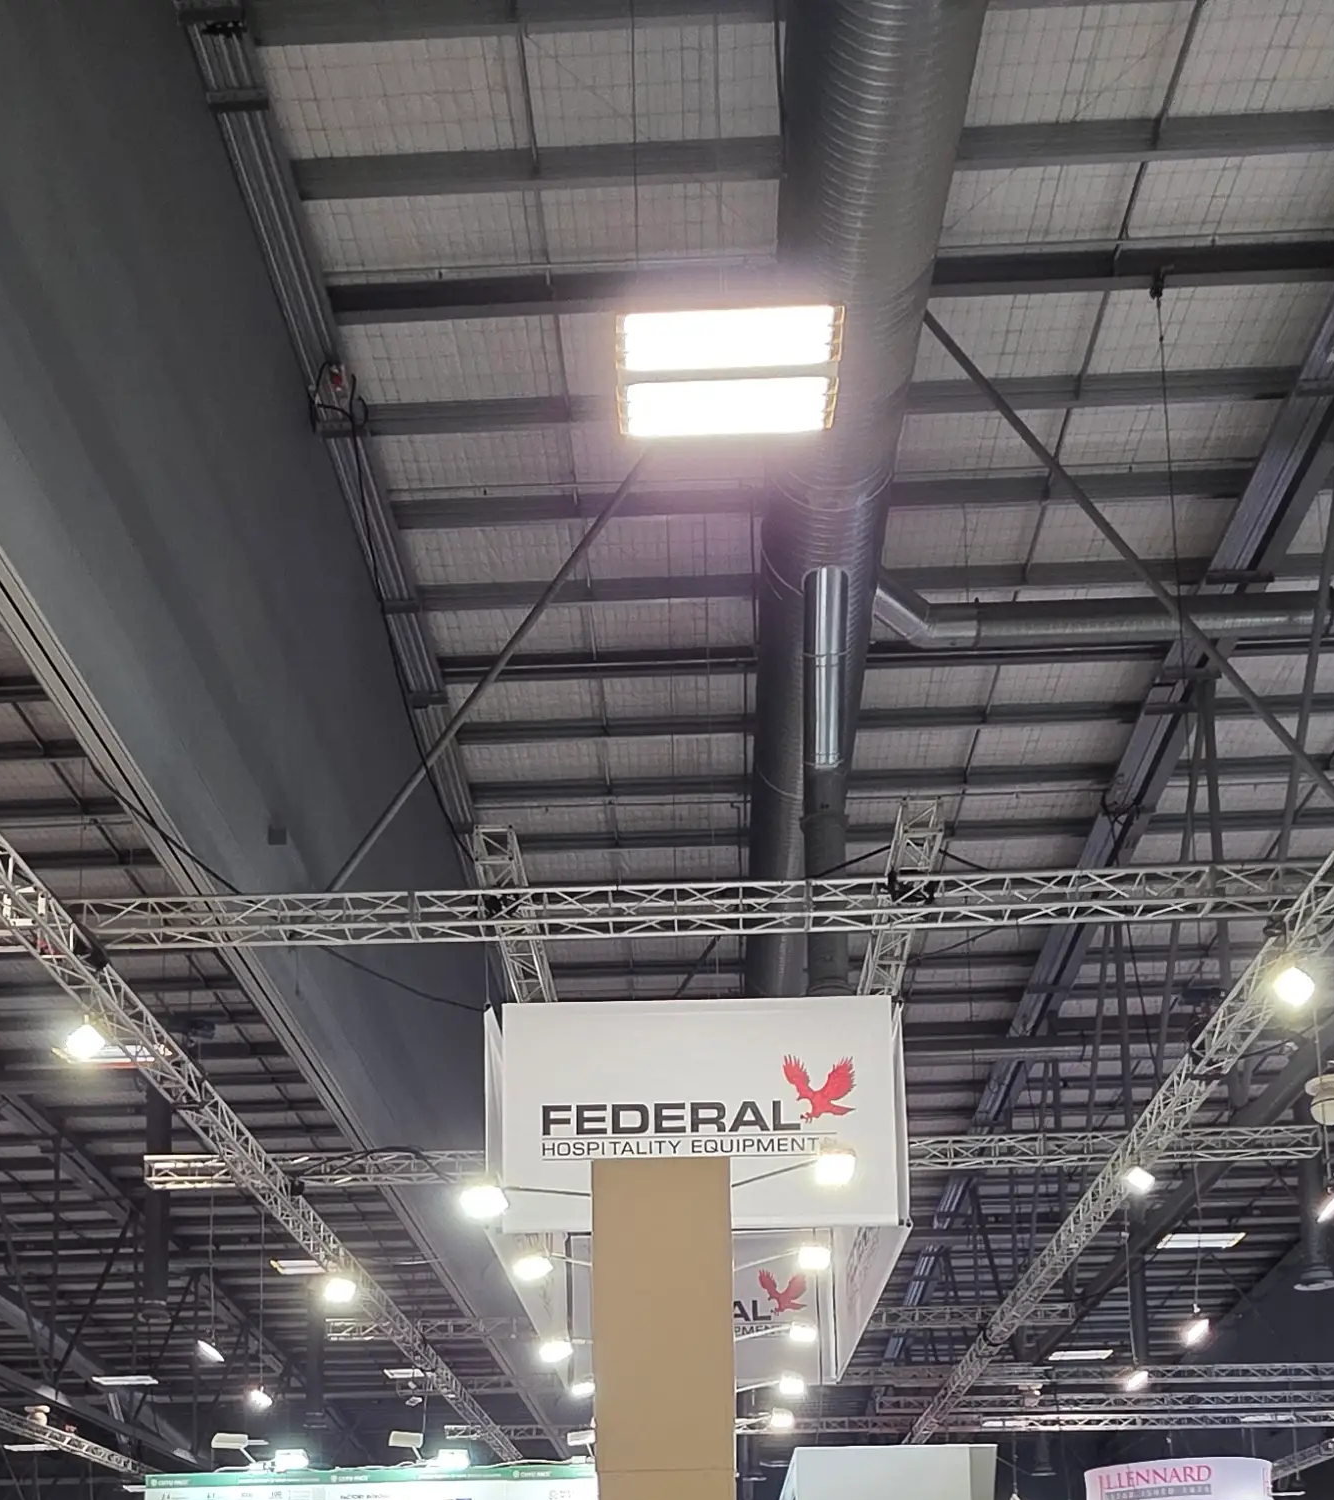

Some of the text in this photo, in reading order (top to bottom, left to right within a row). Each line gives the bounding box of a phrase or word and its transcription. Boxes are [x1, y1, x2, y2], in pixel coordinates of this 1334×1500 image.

[541, 1100, 801, 1136] FEDERAL
[541, 1140, 681, 1157] HOSPITALITY
[691, 1137, 819, 1154] EQUIPMENT
